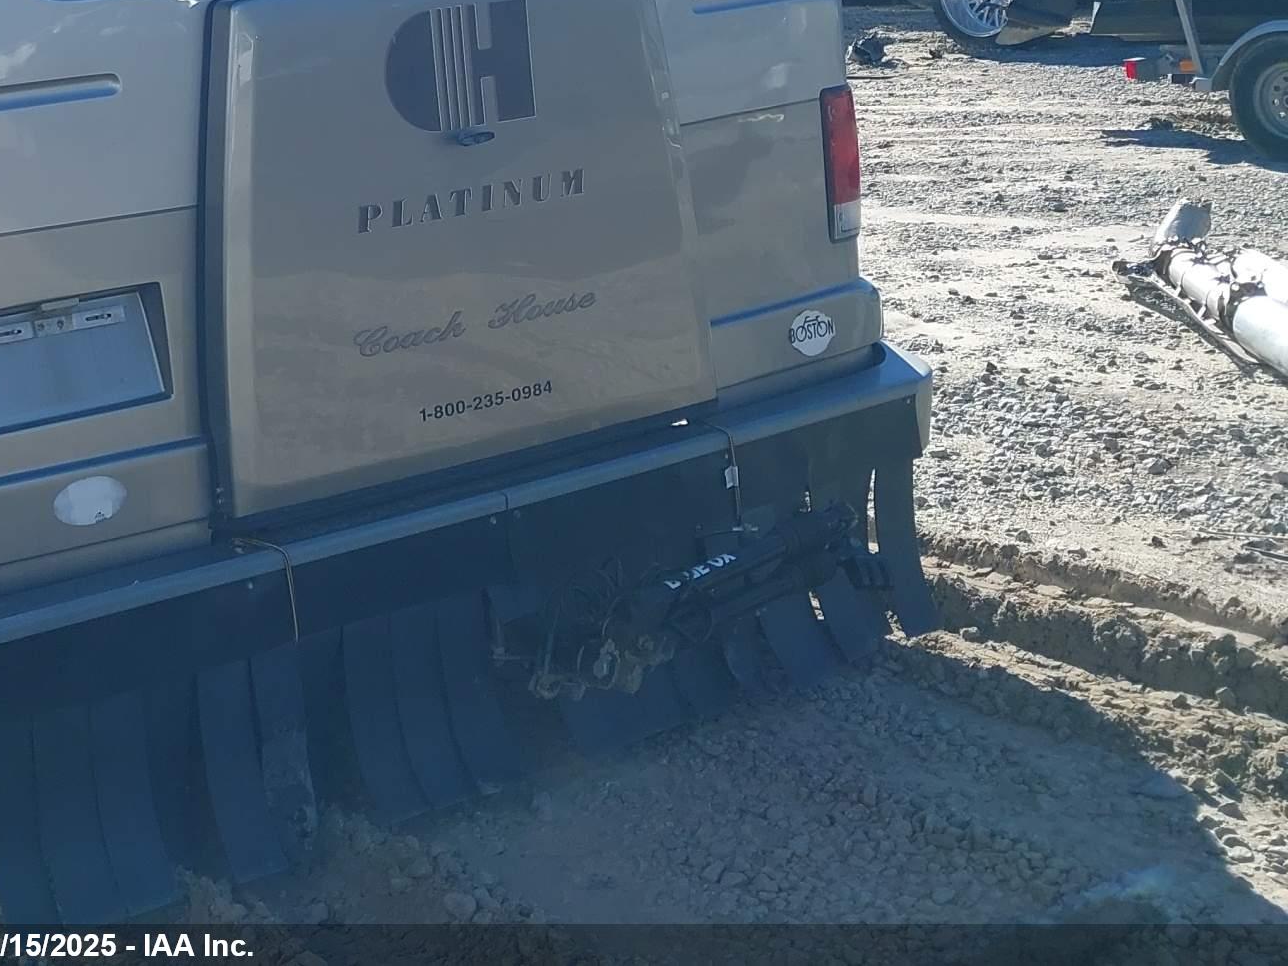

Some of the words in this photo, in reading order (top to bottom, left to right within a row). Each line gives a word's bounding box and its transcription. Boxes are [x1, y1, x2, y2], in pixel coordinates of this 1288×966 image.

[357, 168, 585, 235] PLATINUM
[353, 310, 467, 357] Coach
[487, 291, 597, 329] House
[788, 317, 834, 344] BOSTON
[419, 380, 553, 422] 1-800-235-0984
